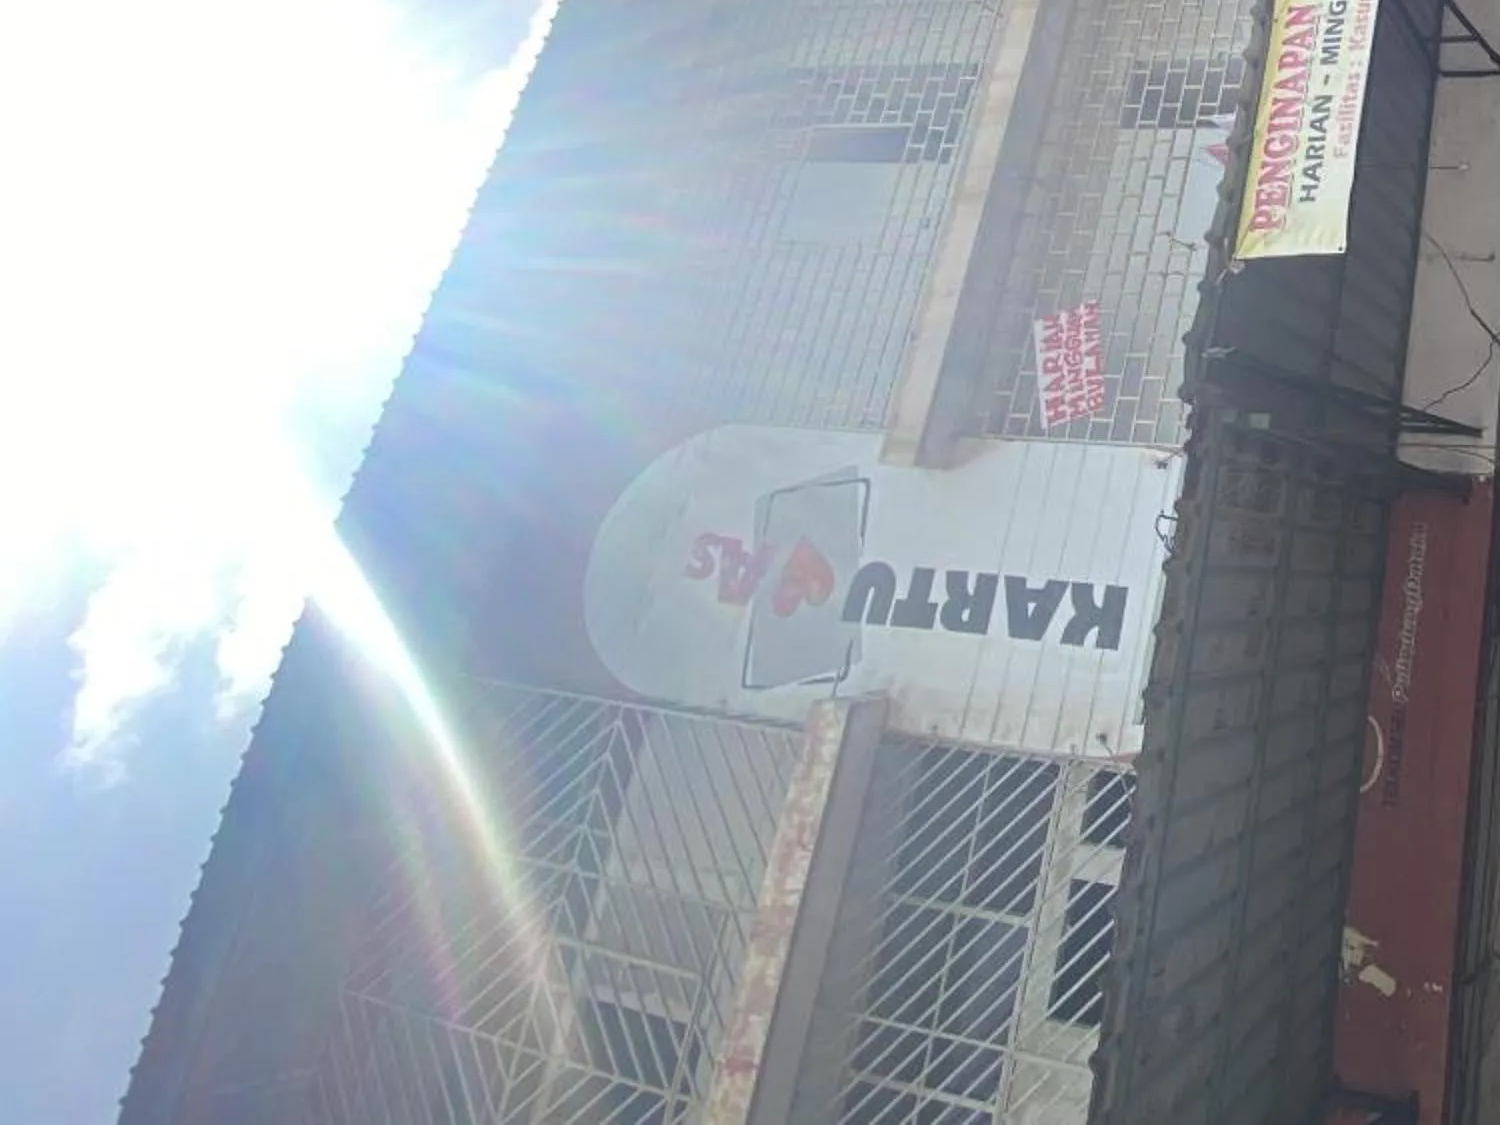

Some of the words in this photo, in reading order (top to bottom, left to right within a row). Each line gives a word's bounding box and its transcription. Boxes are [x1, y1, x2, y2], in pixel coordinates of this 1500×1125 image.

[1247, 2, 1320, 233] PENGINAPAN
[1298, 94, 1334, 204] HARIAN
[684, 532, 776, 606] AS
[840, 561, 1129, 652] KARTU
